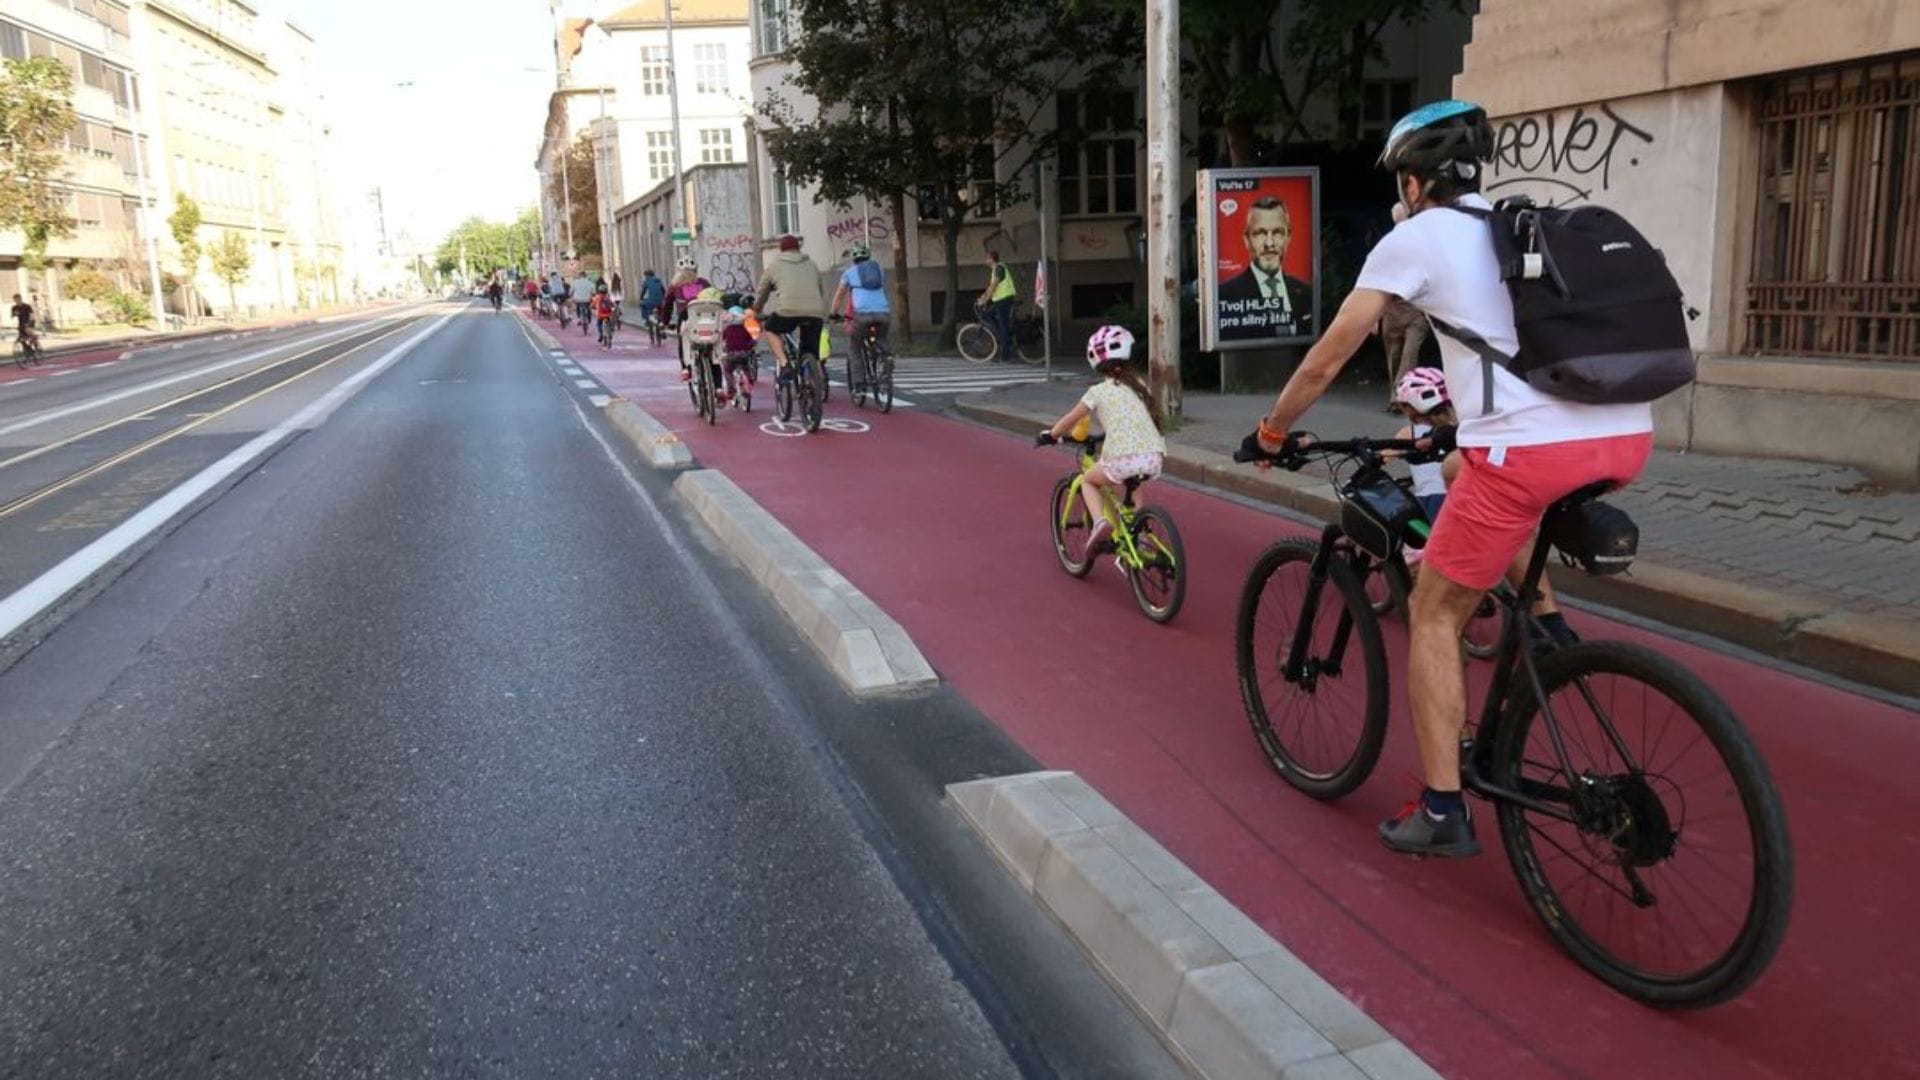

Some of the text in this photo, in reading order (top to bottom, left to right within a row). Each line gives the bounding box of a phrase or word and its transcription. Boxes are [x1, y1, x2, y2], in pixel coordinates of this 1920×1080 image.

[1244, 180, 1254, 190] 17
[1220, 298, 1281, 314] Tvoj HLAS
[1220, 317, 1240, 329] pre
[1241, 313, 1268, 327] silný
